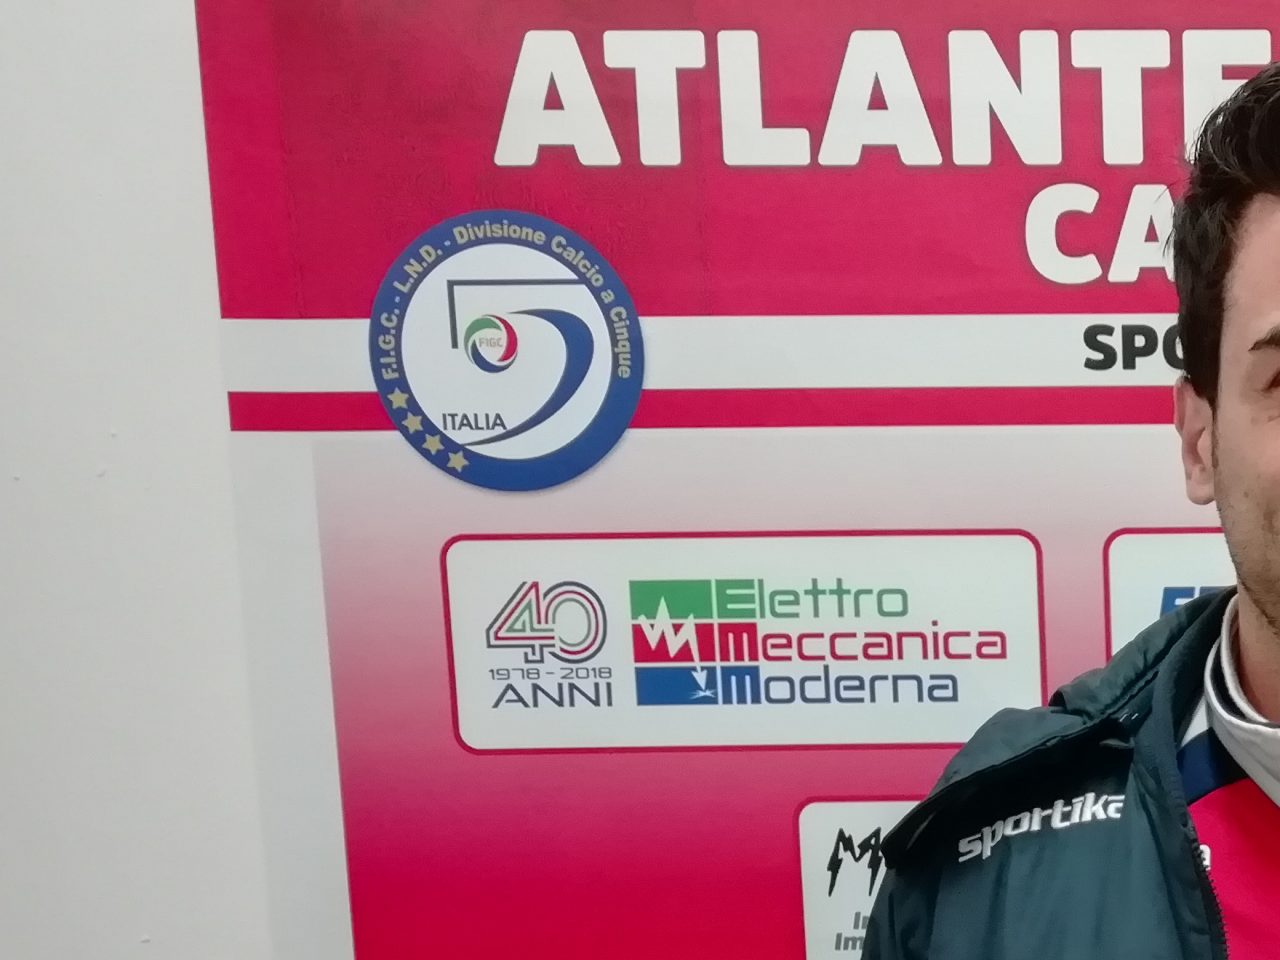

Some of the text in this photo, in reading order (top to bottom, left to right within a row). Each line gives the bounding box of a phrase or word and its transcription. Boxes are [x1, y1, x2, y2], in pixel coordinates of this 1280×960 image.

[494, 29, 1272, 167] ATLANTE
[378, 307, 400, 381] F.I.G.C.
[393, 244, 443, 294] L.N.D.
[453, 220, 547, 244] Divisione
[551, 235, 604, 287] Calcio
[601, 290, 615, 304] a
[610, 306, 631, 379] Cinque
[441, 412, 508, 431] ITALIA
[715, 577, 910, 619] Elettro
[486, 581, 607, 664] 40
[488, 668, 540, 681] 1978
[560, 667, 613, 680] 2018
[491, 682, 613, 709] ANNI
